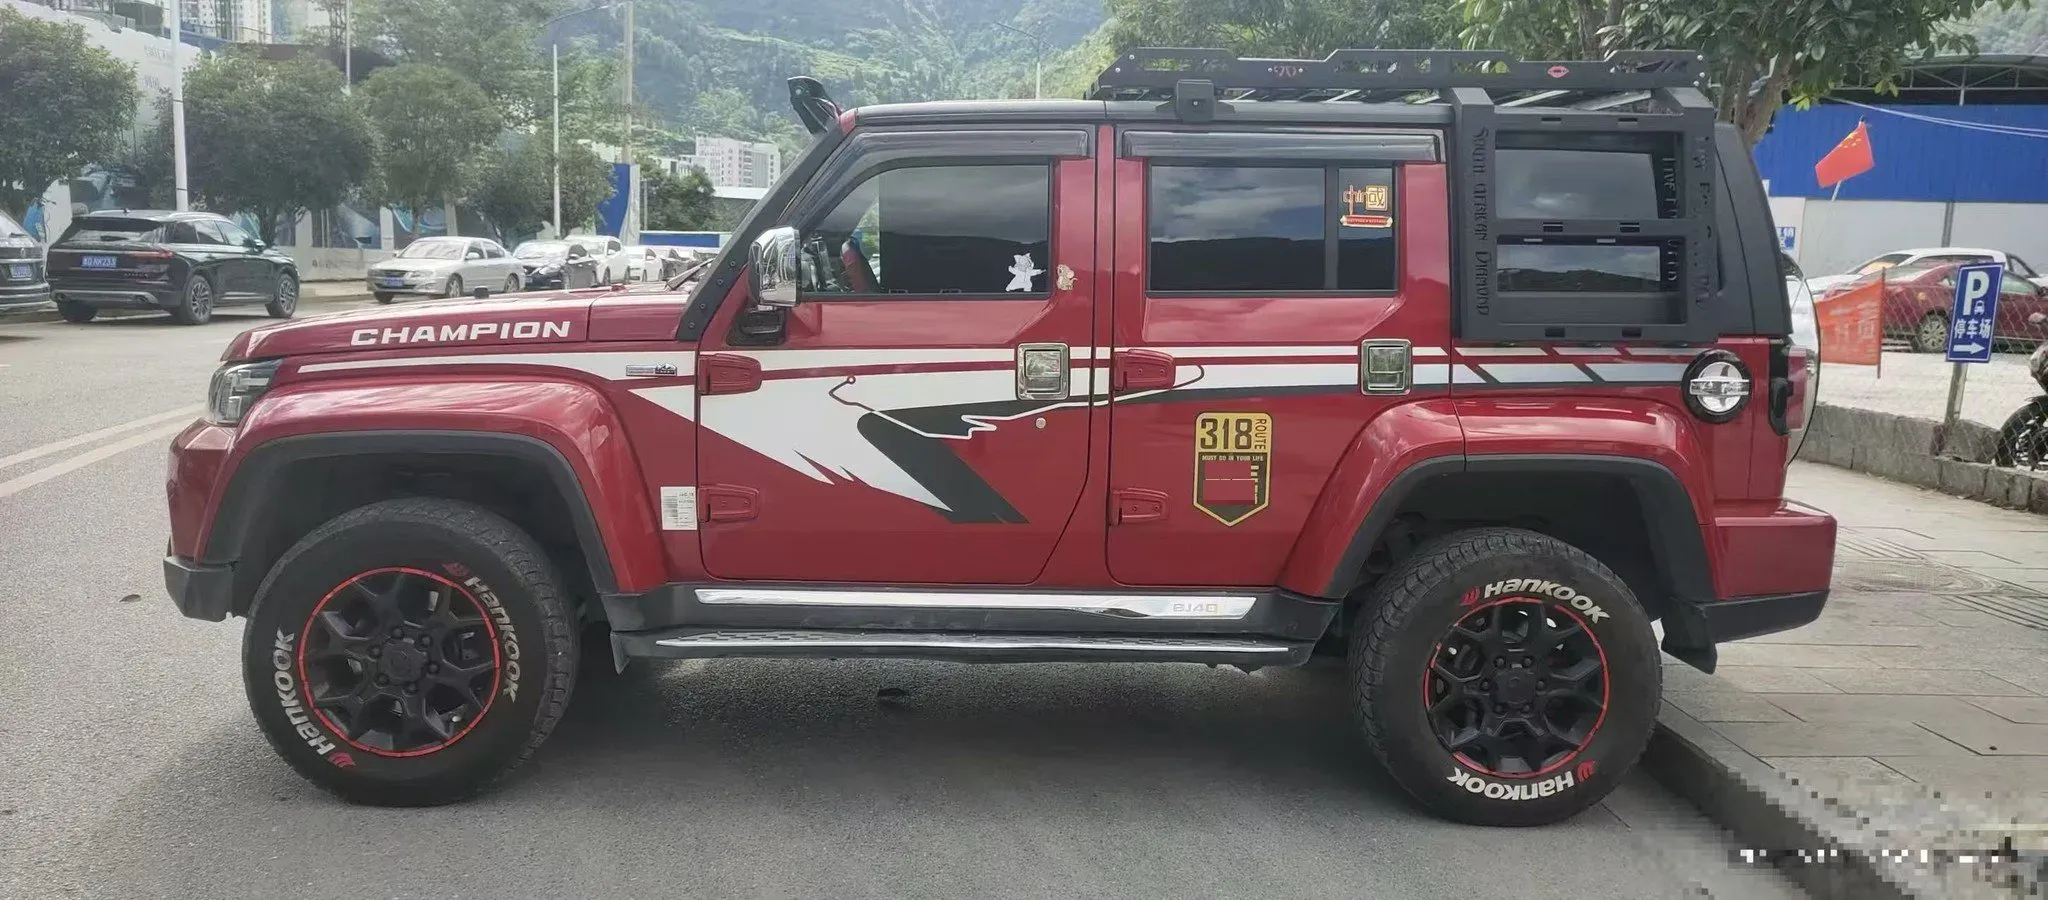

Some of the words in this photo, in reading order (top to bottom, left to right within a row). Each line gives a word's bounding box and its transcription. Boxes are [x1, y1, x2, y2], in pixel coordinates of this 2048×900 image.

[1963, 271, 1989, 316] P
[351, 321, 571, 346] CHAMPION
[1954, 318, 1991, 339] 停车场
[1200, 418, 1253, 449] 318
[1254, 418, 1267, 449] ROUTE
